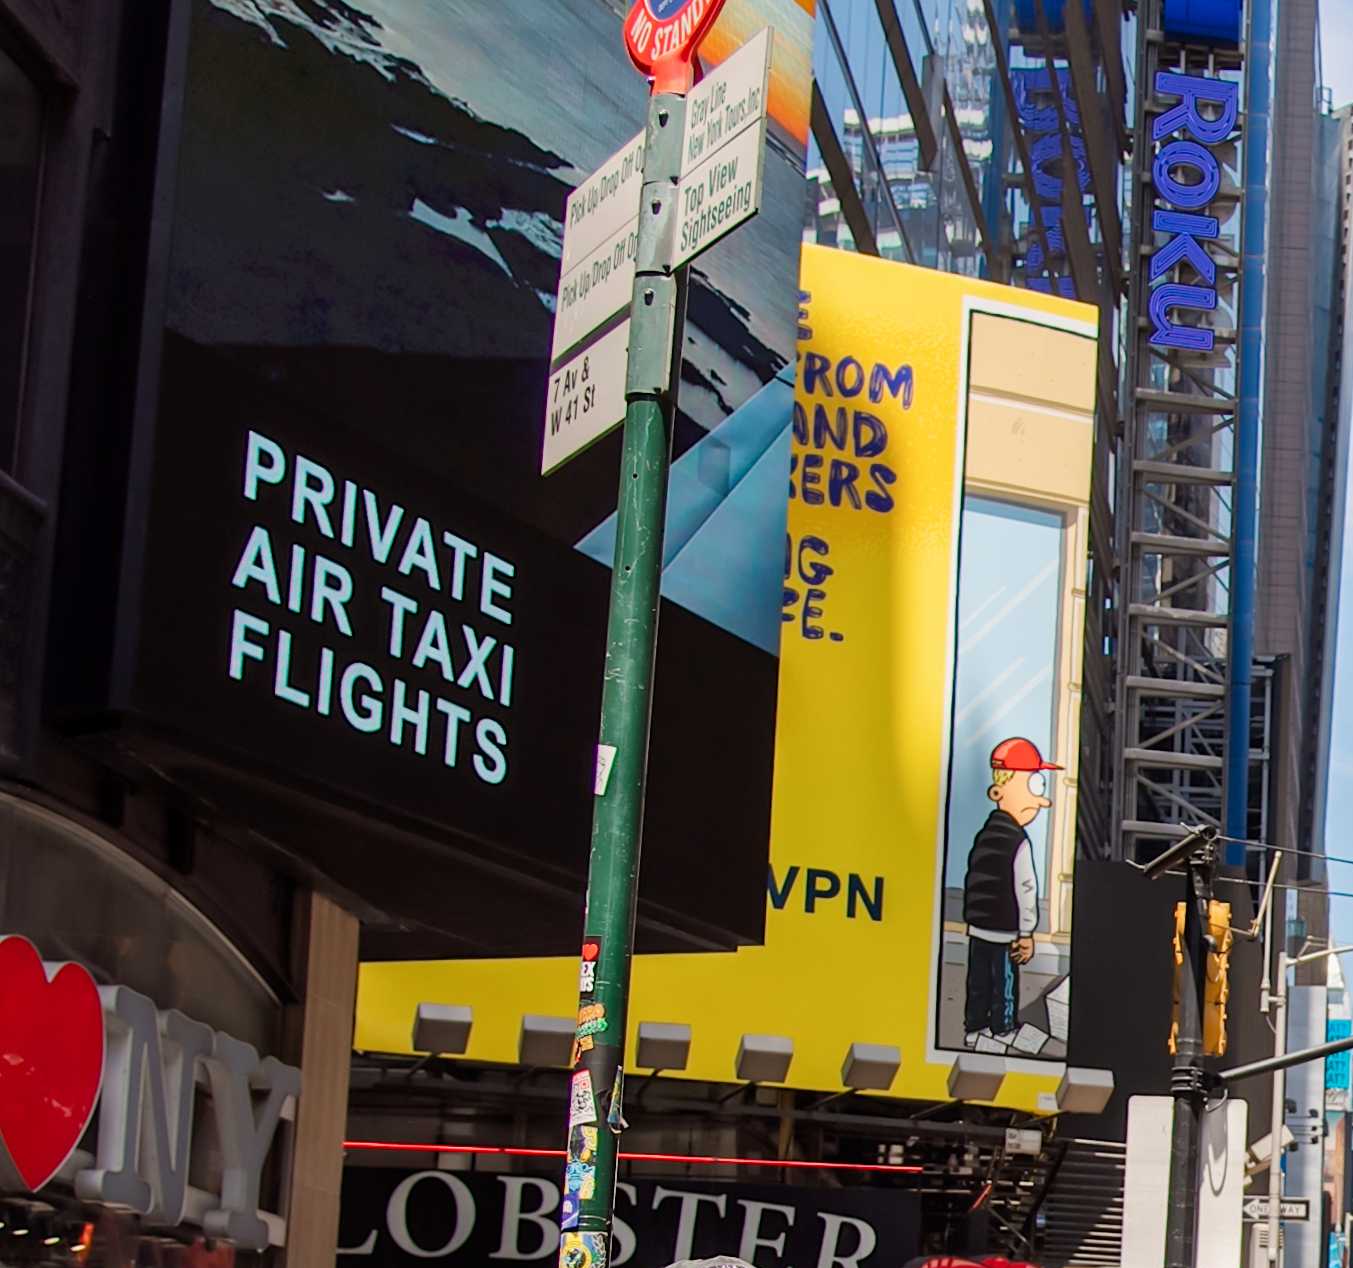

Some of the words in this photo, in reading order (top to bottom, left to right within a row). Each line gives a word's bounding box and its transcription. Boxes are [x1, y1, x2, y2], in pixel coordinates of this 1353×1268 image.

[631, 8, 653, 54] NO
[691, 96, 708, 129] Gray
[709, 82, 727, 114] Line
[688, 131, 704, 163] New
[706, 113, 724, 146] York
[587, 186, 599, 218] Up
[600, 171, 619, 206] Drop
[620, 153, 635, 184] Off
[684, 184, 704, 218] Top
[708, 156, 738, 195] View
[681, 180, 753, 252] Sightseeing
[579, 270, 590, 299] Up
[592, 255, 612, 287] Drop
[613, 239, 625, 270] Off
[554, 378, 561, 401] 7
[563, 368, 578, 396] Av
[581, 355, 590, 383] &
[796, 352, 914, 411] ROM
[550, 411, 562, 436] W
[565, 394, 579, 424] 41
[583, 382, 596, 414] St
[243, 430, 515, 625] PRIVATE
[232, 527, 352, 637] AIR
[381, 587, 514, 707] TAXI
[229, 611, 508, 785] FLIGHTS
[768, 864, 885, 924] VPN
[98, 984, 301, 1252] NY
[1250, 1204, 1270, 1217] ONE
[1280, 1203, 1301, 1216] WAY
